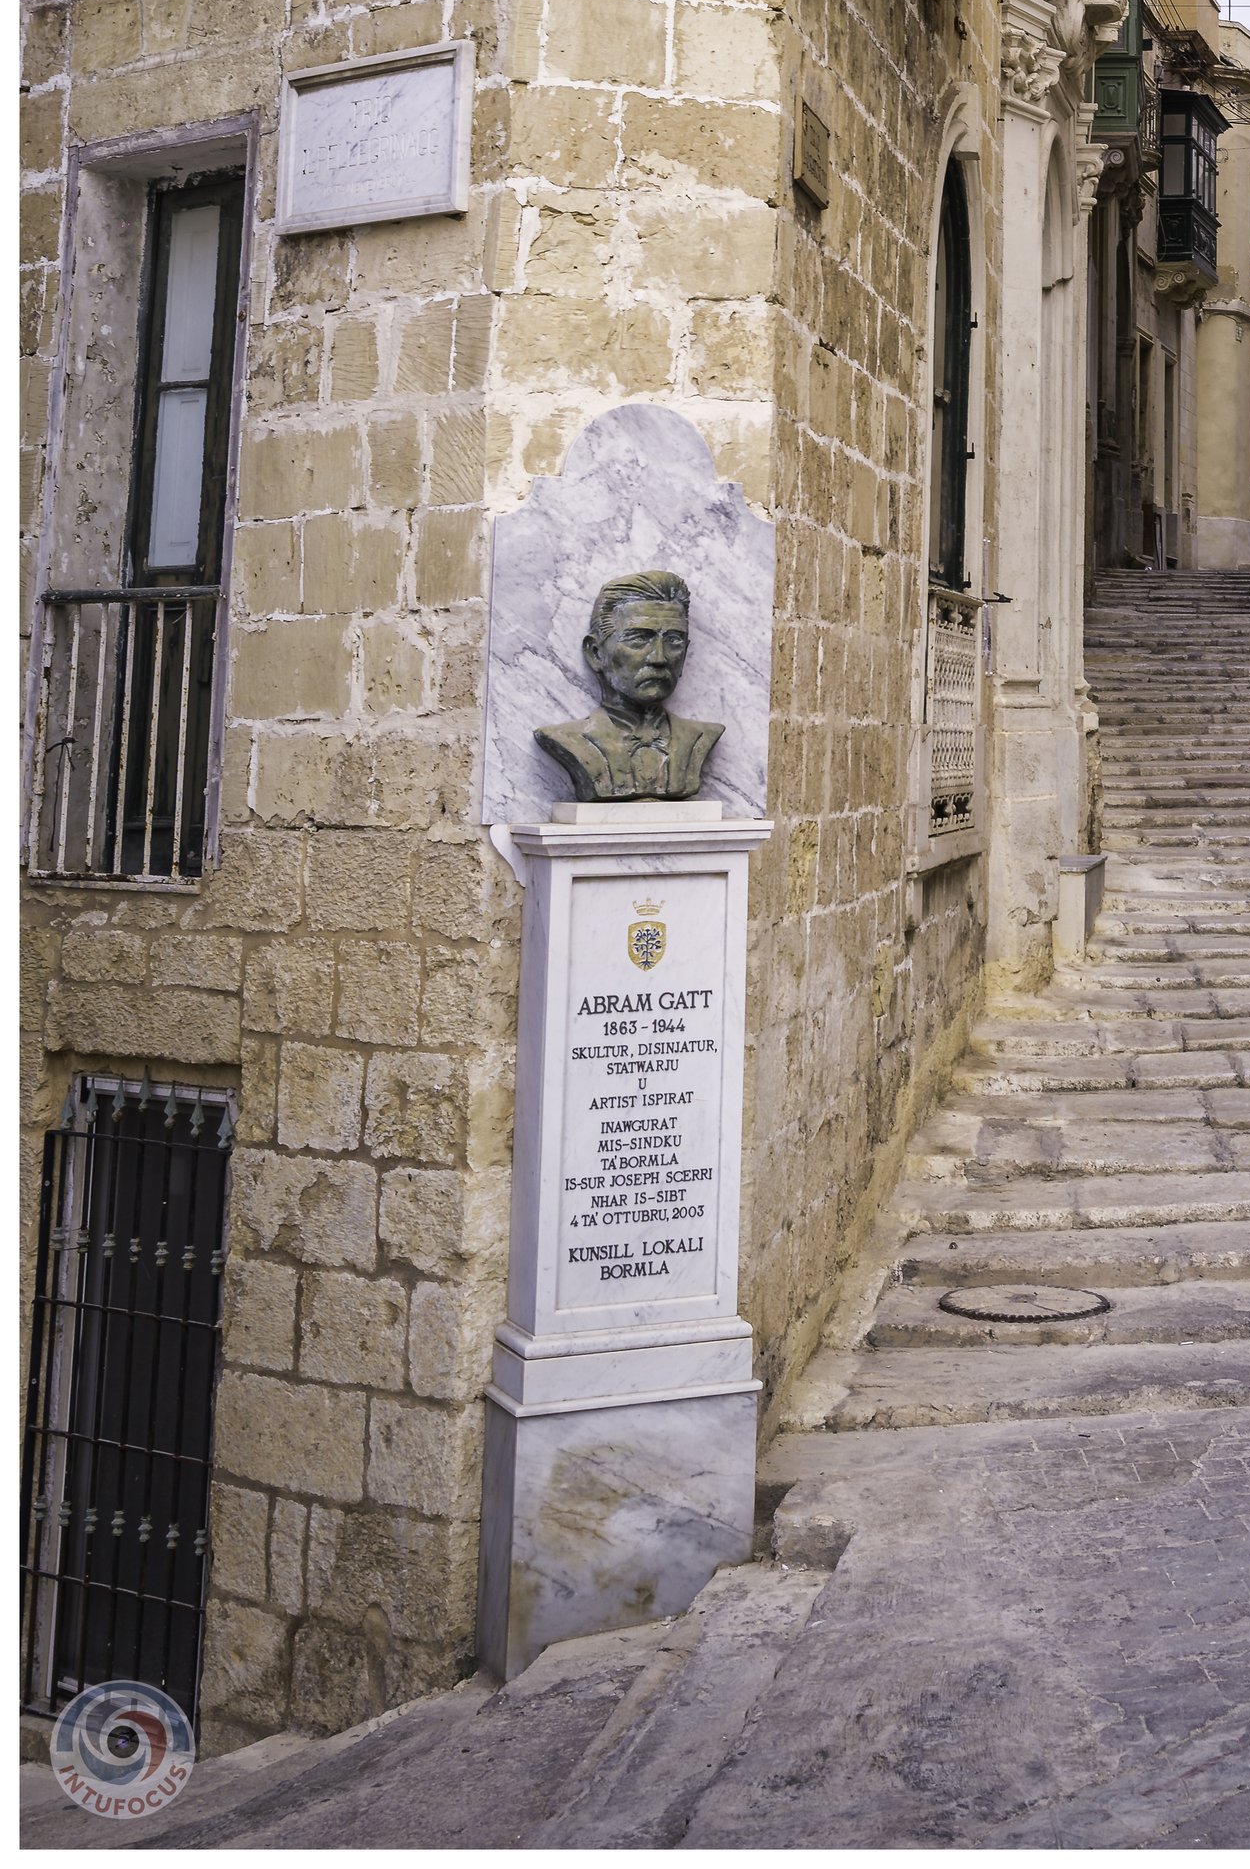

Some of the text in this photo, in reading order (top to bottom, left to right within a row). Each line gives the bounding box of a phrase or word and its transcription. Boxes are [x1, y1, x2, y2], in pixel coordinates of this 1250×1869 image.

[577, 989, 713, 1016] ABRAM GATT
[603, 1020, 638, 1036] 1863
[651, 1018, 686, 1034] 1944
[571, 1039, 719, 1060] SKULTUR, DISINJATUR,
[606, 1058, 680, 1075] STATWARJU
[637, 1077, 648, 1091] U
[588, 1090, 695, 1111] ARTIST ISPIRAT
[600, 1116, 678, 1134] INAWGURAT
[597, 1134, 683, 1153] MIS-SINDKU
[564, 1167, 713, 1192] IS-SUR JOSEPH SCERRI
[590, 1188, 687, 1209] NHAR IS-SIBT
[569, 1204, 705, 1228] 4 TA' OTTUBRU, 2003
[568, 1236, 704, 1264] KUNSILL LOKALI
[599, 1259, 670, 1281] BORMLA
